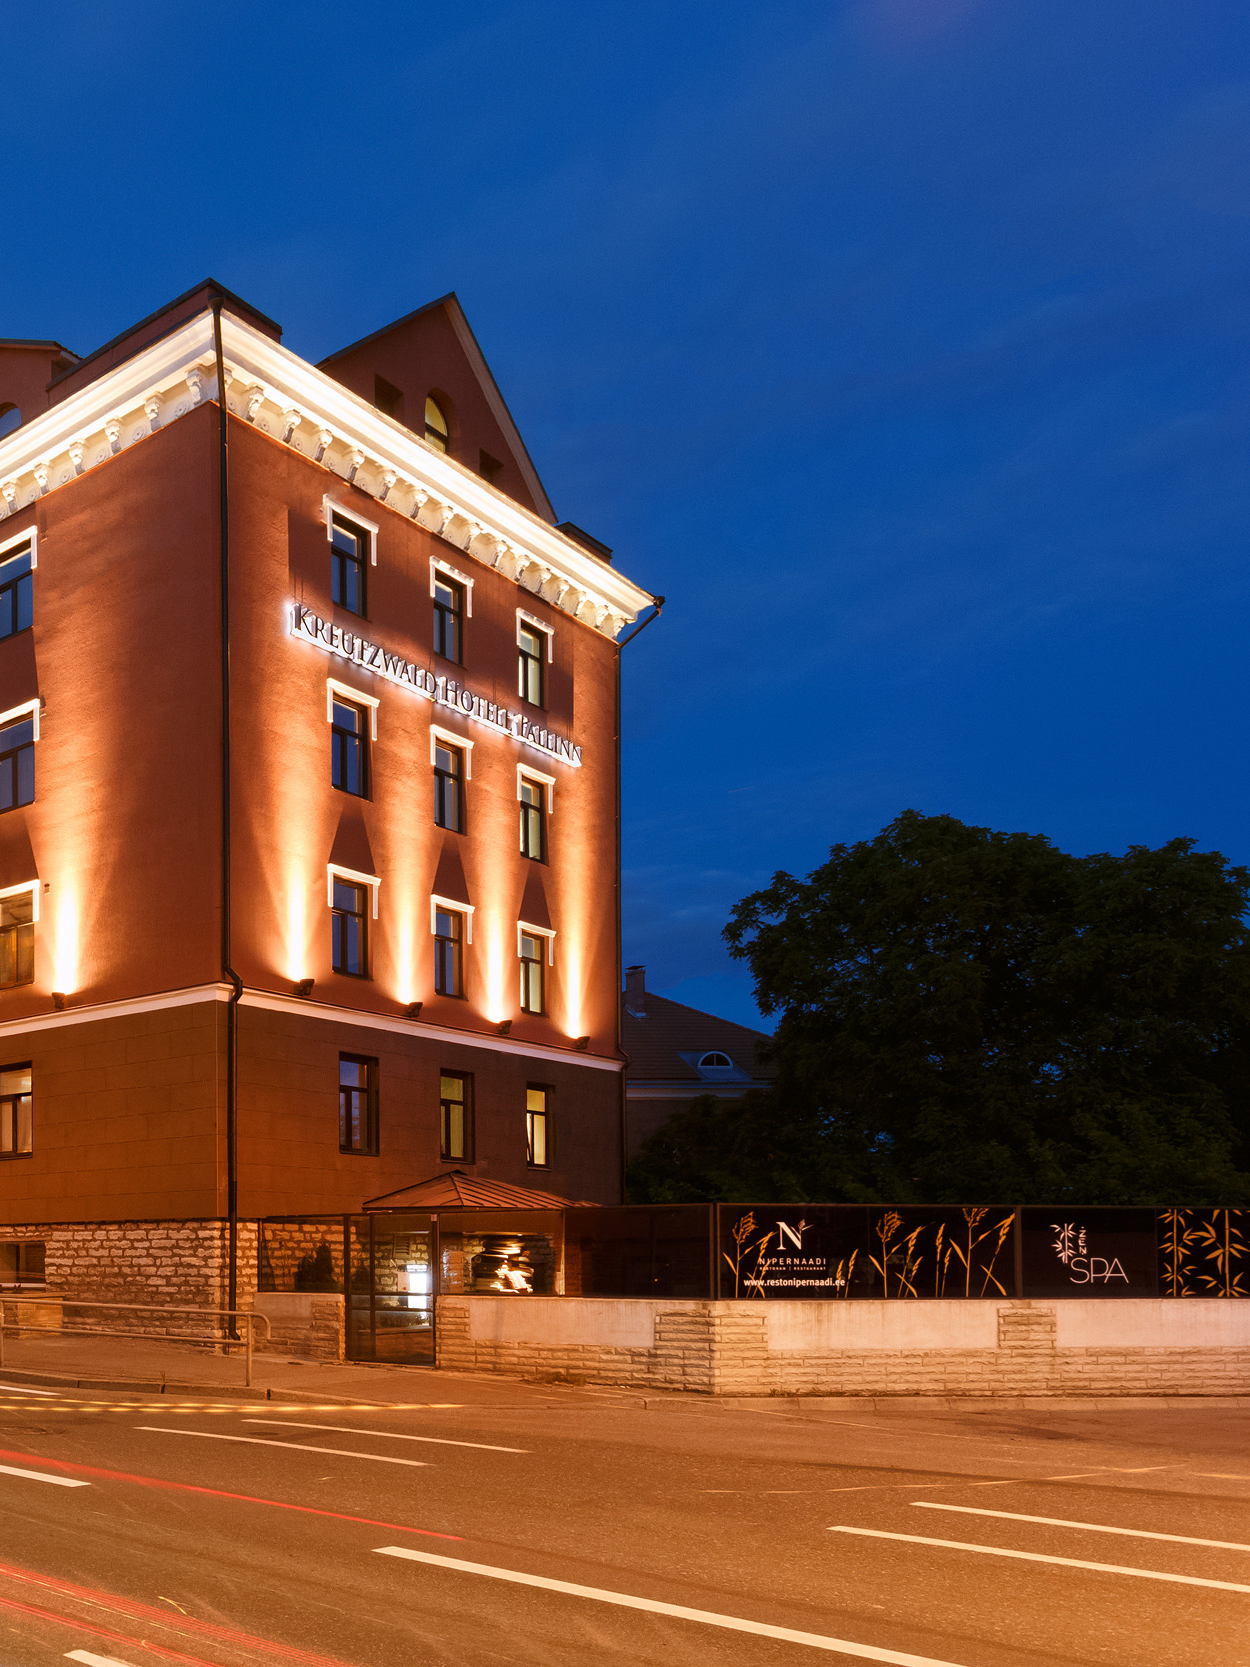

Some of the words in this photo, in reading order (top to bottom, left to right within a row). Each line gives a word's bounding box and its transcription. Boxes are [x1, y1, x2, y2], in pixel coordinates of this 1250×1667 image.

[293, 603, 437, 695] KREUTZWALD
[437, 676, 511, 733] HOTEL
[509, 713, 583, 766] TALLINN
[743, 1278, 846, 1288] www.restonipernaadi.ee
[1070, 1257, 1130, 1284] SPA
